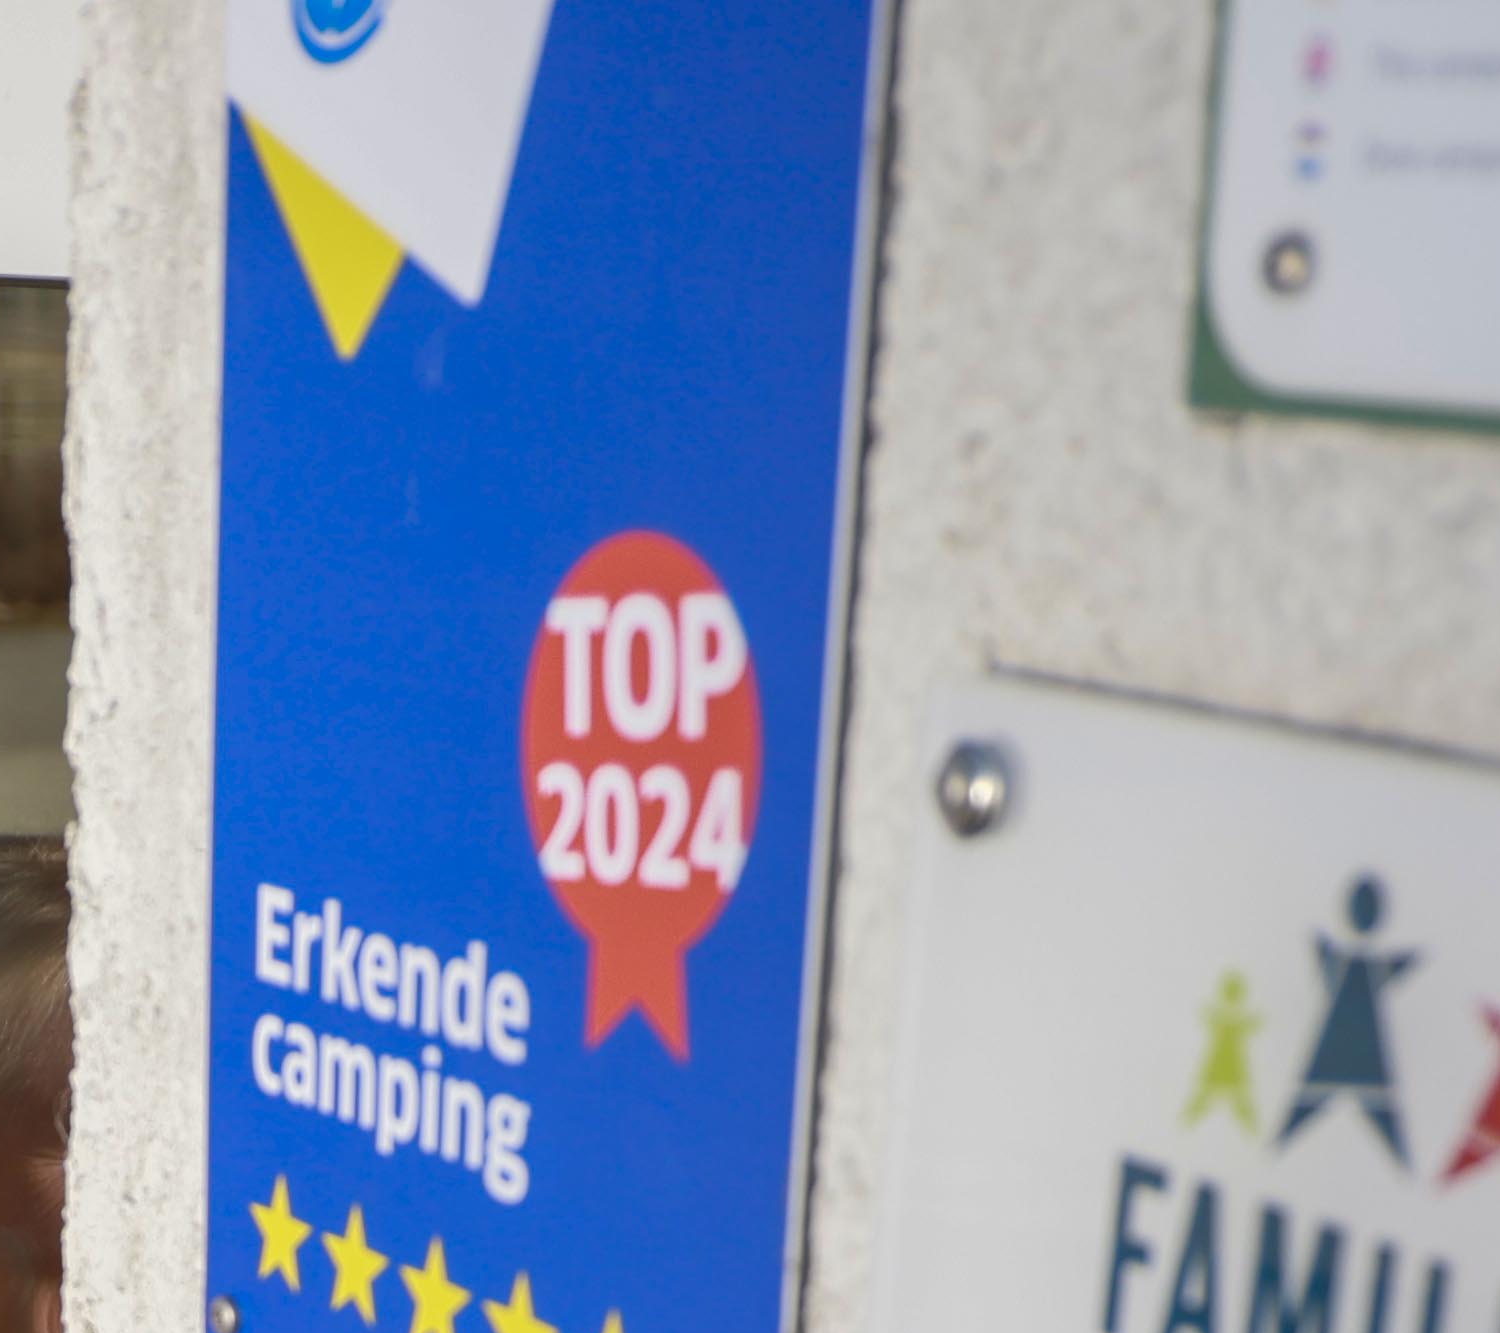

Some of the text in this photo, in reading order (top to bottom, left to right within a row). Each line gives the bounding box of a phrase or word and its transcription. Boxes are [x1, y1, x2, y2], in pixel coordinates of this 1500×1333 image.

[545, 590, 748, 742] TOP
[537, 763, 747, 892] 2024
[255, 882, 531, 1066] Erkende
[251, 1011, 531, 1206] camping
